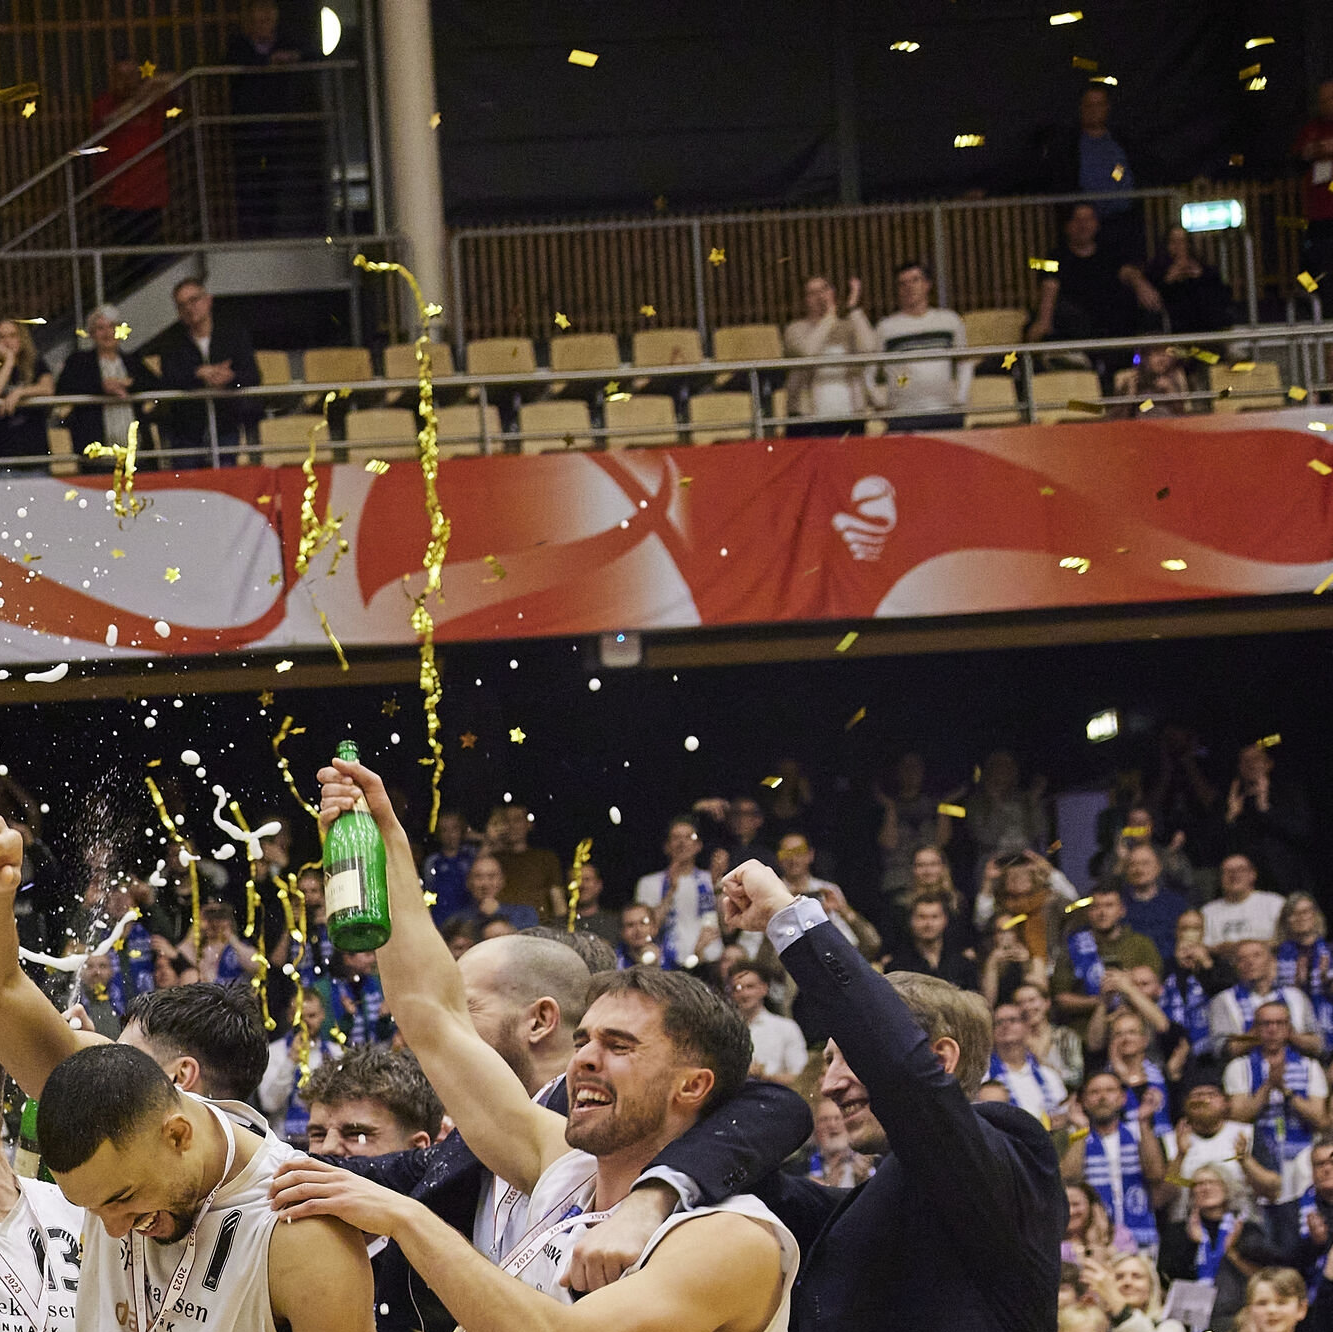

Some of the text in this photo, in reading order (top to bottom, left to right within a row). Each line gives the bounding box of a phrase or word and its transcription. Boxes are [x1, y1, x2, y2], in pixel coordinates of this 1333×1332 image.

[514, 1248, 535, 1269] 2023
[4, 1273, 23, 1294] 2023
[172, 1266, 188, 1292] 2023
